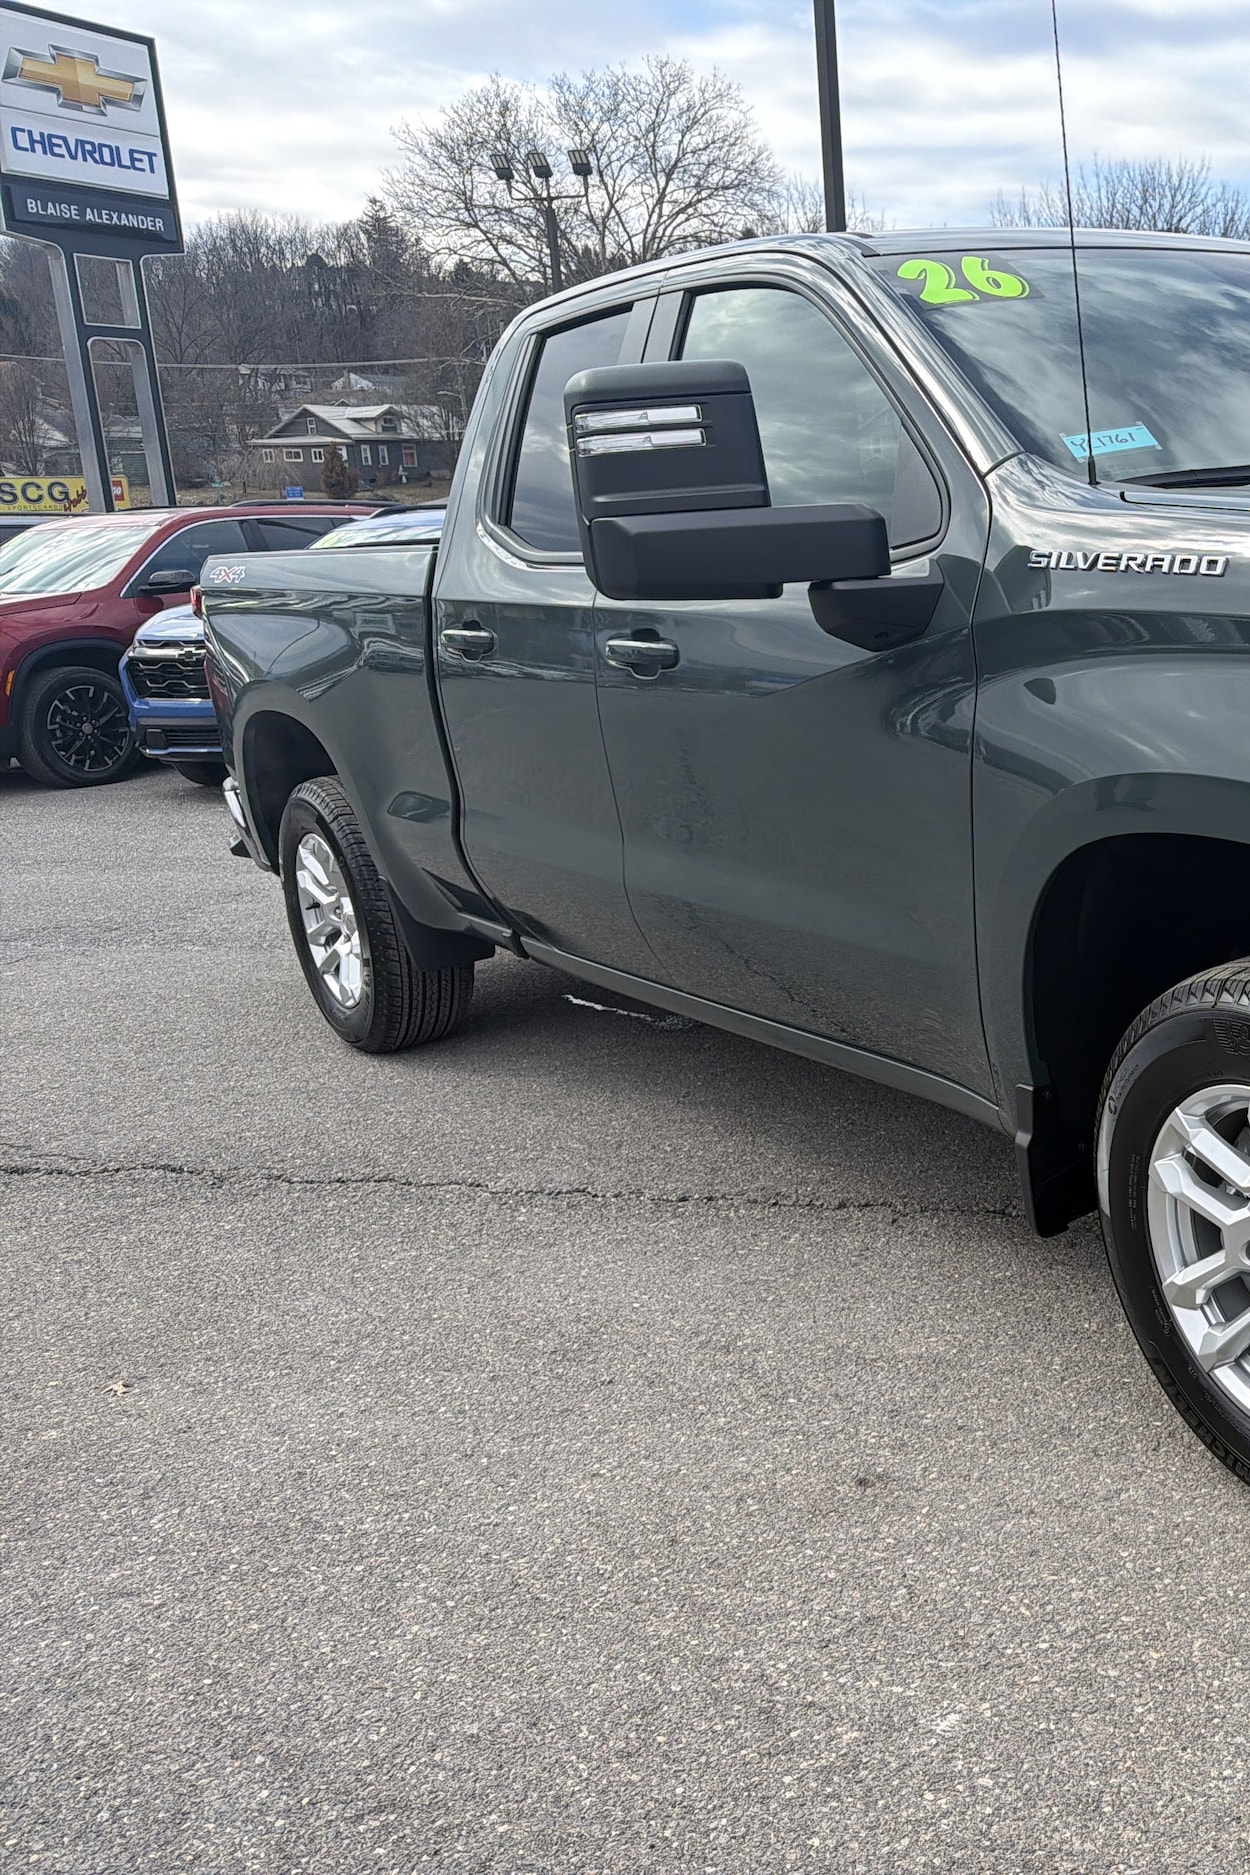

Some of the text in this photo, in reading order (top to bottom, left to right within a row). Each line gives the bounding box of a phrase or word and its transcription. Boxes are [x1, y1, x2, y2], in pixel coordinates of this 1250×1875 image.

[11, 126, 157, 174] CHEVROLET
[27, 198, 164, 232] BLAISE ALEXANDER
[897, 256, 1031, 304] 26
[64, 485, 88, 511] Hobb
[1027, 550, 1230, 577] SILVERADO
